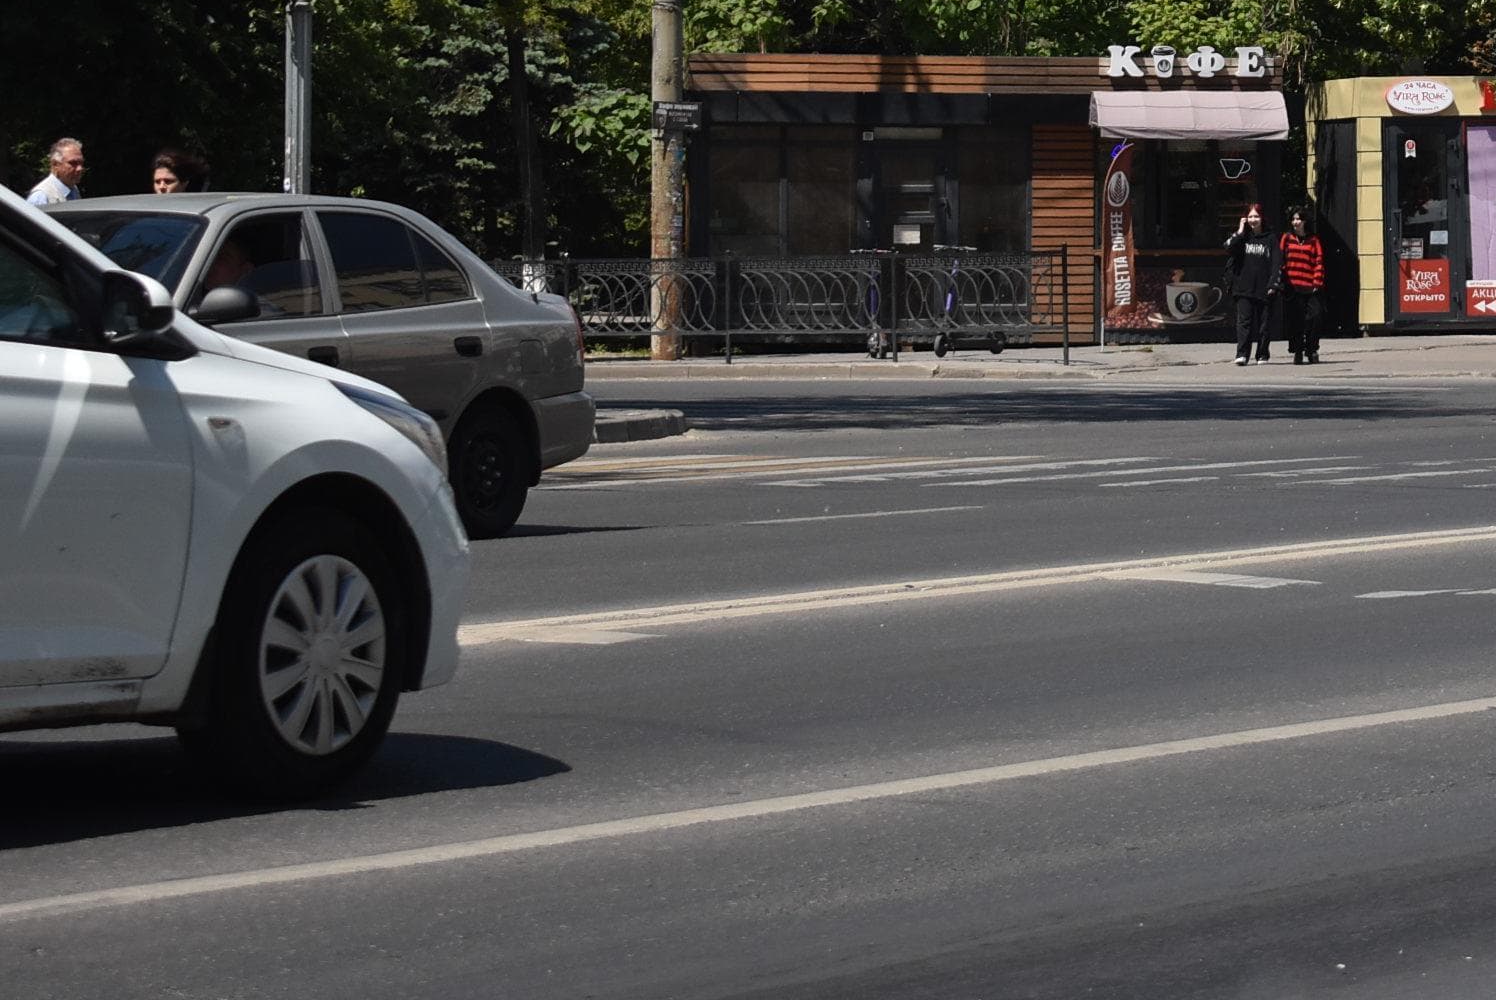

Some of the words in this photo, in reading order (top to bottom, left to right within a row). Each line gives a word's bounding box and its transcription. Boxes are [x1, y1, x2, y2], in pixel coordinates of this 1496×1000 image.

[1110, 211, 1127, 252] COFFEE
[1113, 256, 1132, 306] ROSETTA
[1403, 293, 1446, 302] ОТКРЫТО
